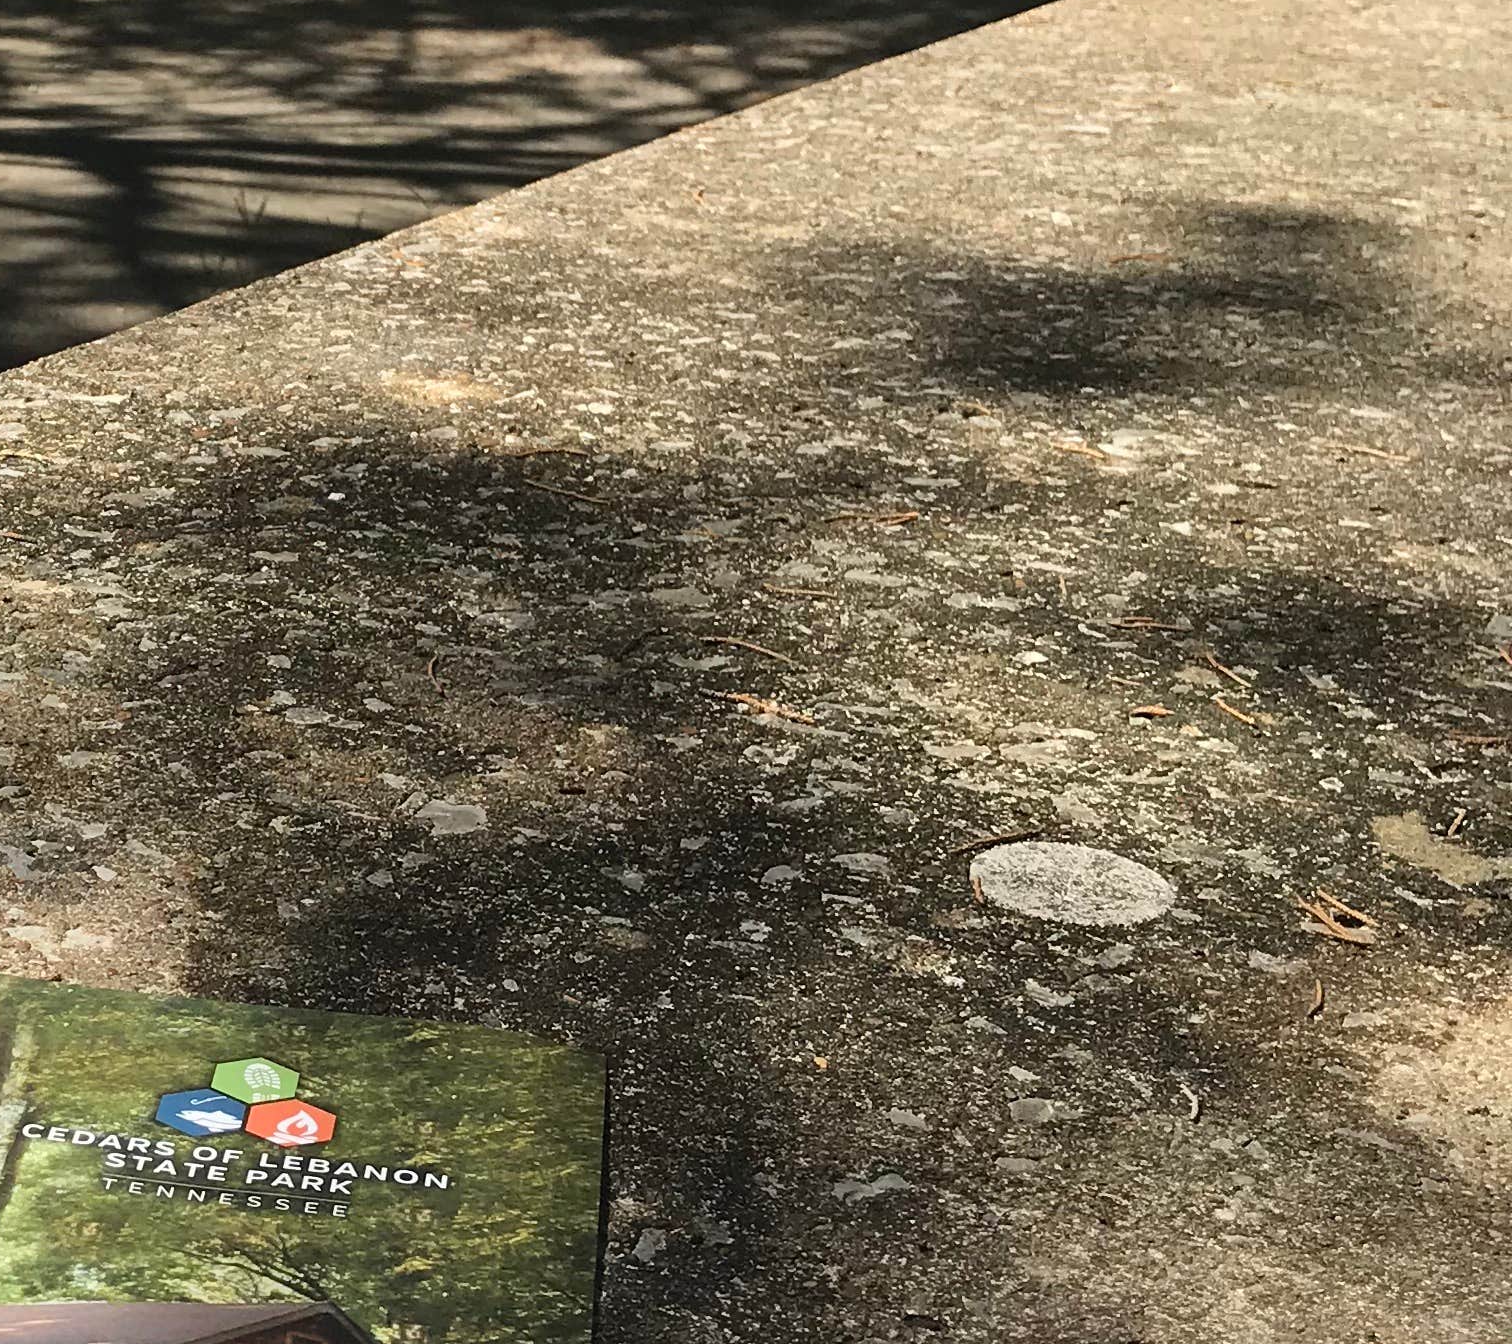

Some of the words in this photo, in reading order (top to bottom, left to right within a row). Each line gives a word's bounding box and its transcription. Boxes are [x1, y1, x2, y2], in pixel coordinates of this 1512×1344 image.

[21, 1122, 177, 1158] CEDARS
[192, 1145, 244, 1167] OF
[258, 1152, 450, 1191] LEBANON
[104, 1153, 227, 1183] STATE
[245, 1169, 354, 1196] PARK
[103, 1178, 350, 1219] TENNESSEE
